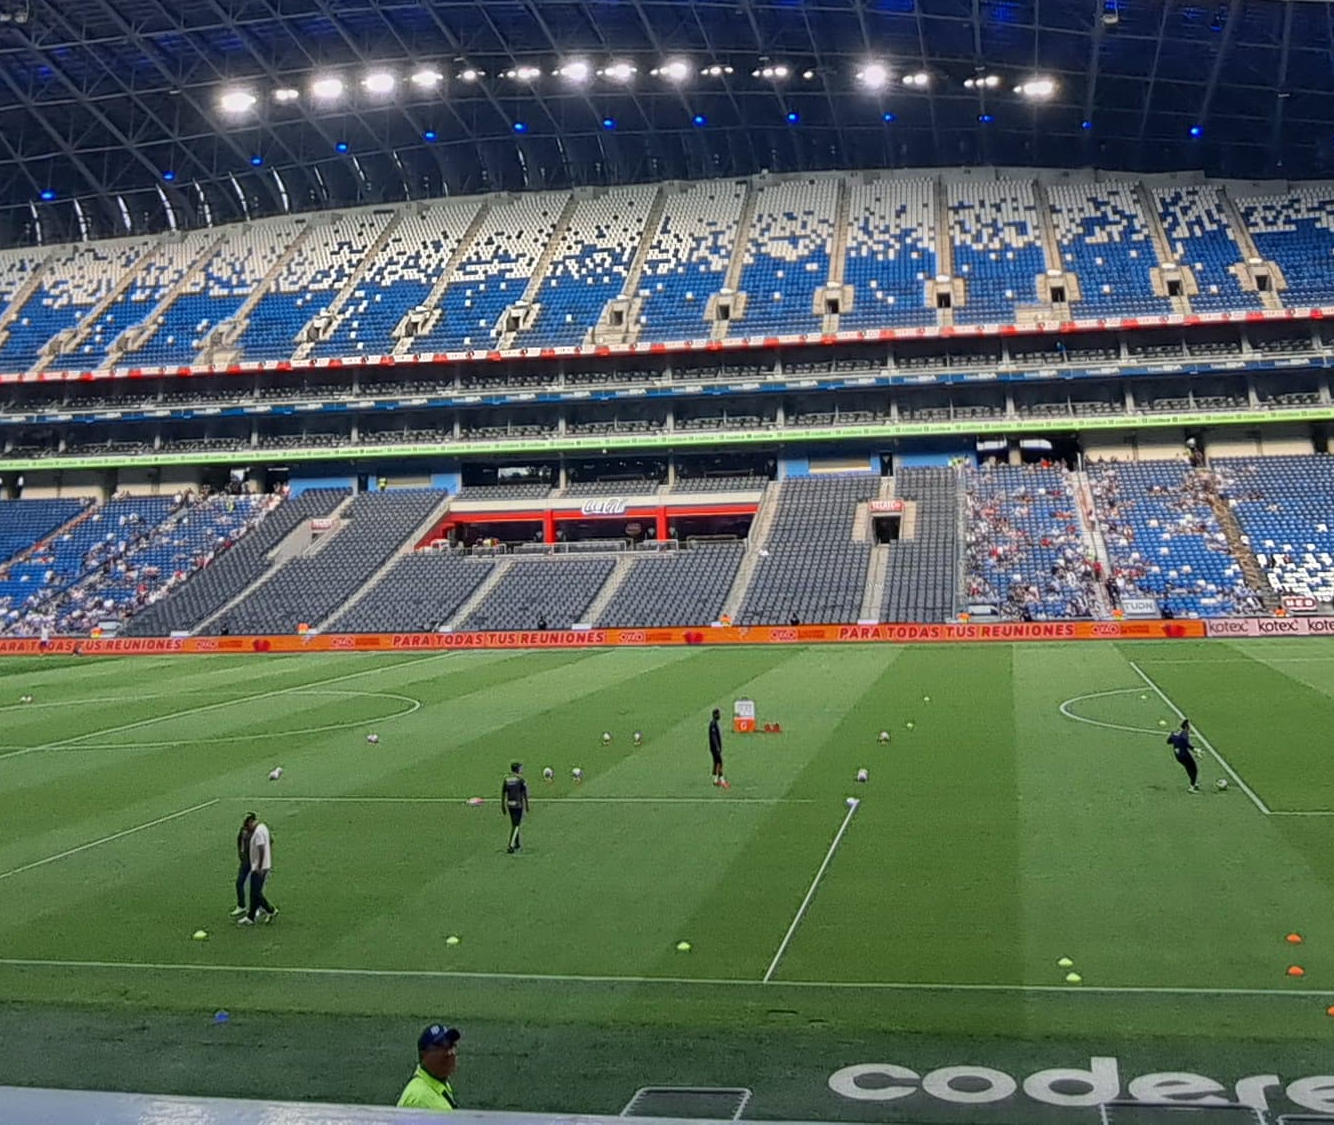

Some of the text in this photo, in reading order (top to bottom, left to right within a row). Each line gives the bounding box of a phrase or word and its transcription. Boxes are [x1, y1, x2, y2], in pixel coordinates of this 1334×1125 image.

[839, 624, 1075, 639] PARA TODAS TUS REUNIONES
[1209, 620, 1248, 633] kotex
[1258, 619, 1299, 633] kotex
[106, 639, 182, 651] REUNIONES
[393, 636, 430, 647] PARA
[436, 634, 483, 645] TODAS
[487, 633, 515, 644] TUS
[520, 632, 604, 644] REUNIONES
